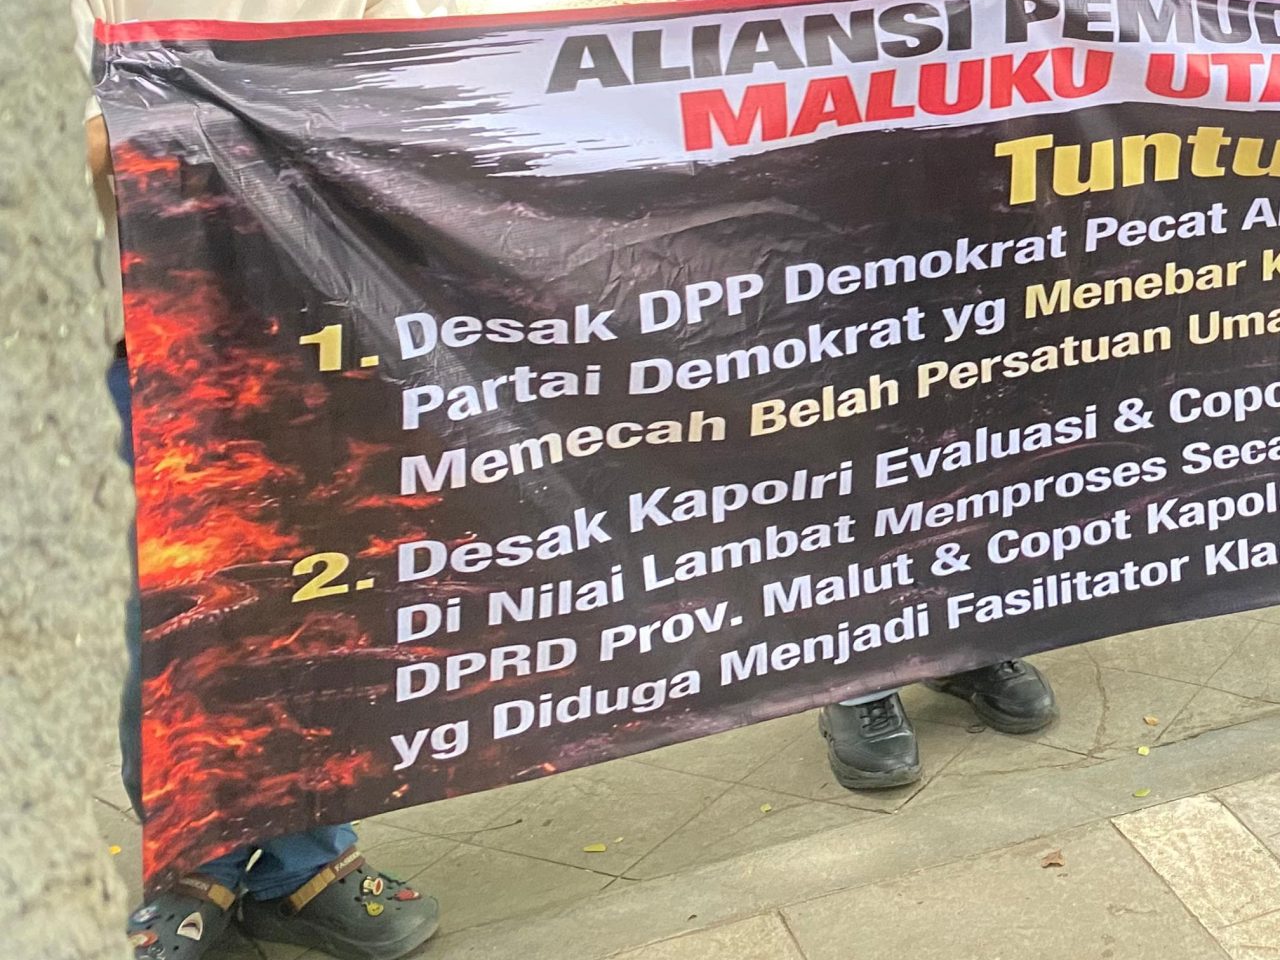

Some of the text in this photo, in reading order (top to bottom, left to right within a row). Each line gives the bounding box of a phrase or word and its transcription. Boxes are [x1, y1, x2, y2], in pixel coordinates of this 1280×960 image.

[680, 47, 1114, 152] MALUKU
[299, 323, 379, 372] 1.
[394, 303, 619, 361] Desak
[638, 272, 765, 335] DPP
[785, 225, 1067, 305] Demokrat
[1085, 202, 1228, 253] Pecat
[401, 364, 602, 431] Partai
[628, 306, 926, 395] Demokrat
[943, 297, 1007, 344] yg
[1024, 258, 1248, 320] Menebar
[291, 550, 375, 603] 2.
[397, 507, 613, 583] Desak
[629, 459, 853, 534] Kapolri
[875, 403, 1098, 489] Evaluasi
[1113, 396, 1155, 435] &
[400, 410, 727, 496] Memecah
[750, 373, 900, 438] Belah
[917, 324, 1172, 399] Persatuan
[395, 636, 578, 703] DPRD
[599, 600, 744, 663] Prov.
[763, 553, 915, 618] Malut
[929, 541, 973, 577] &
[986, 508, 1132, 565] Copot
[396, 597, 461, 644] Di
[487, 564, 625, 626] Nilai
[643, 514, 856, 592] Lambat
[873, 455, 1168, 538] Memproses
[389, 719, 471, 771] yg
[491, 668, 702, 741] Diduga
[719, 601, 931, 687] Menjadi
[945, 553, 1191, 630] Fasilitator
